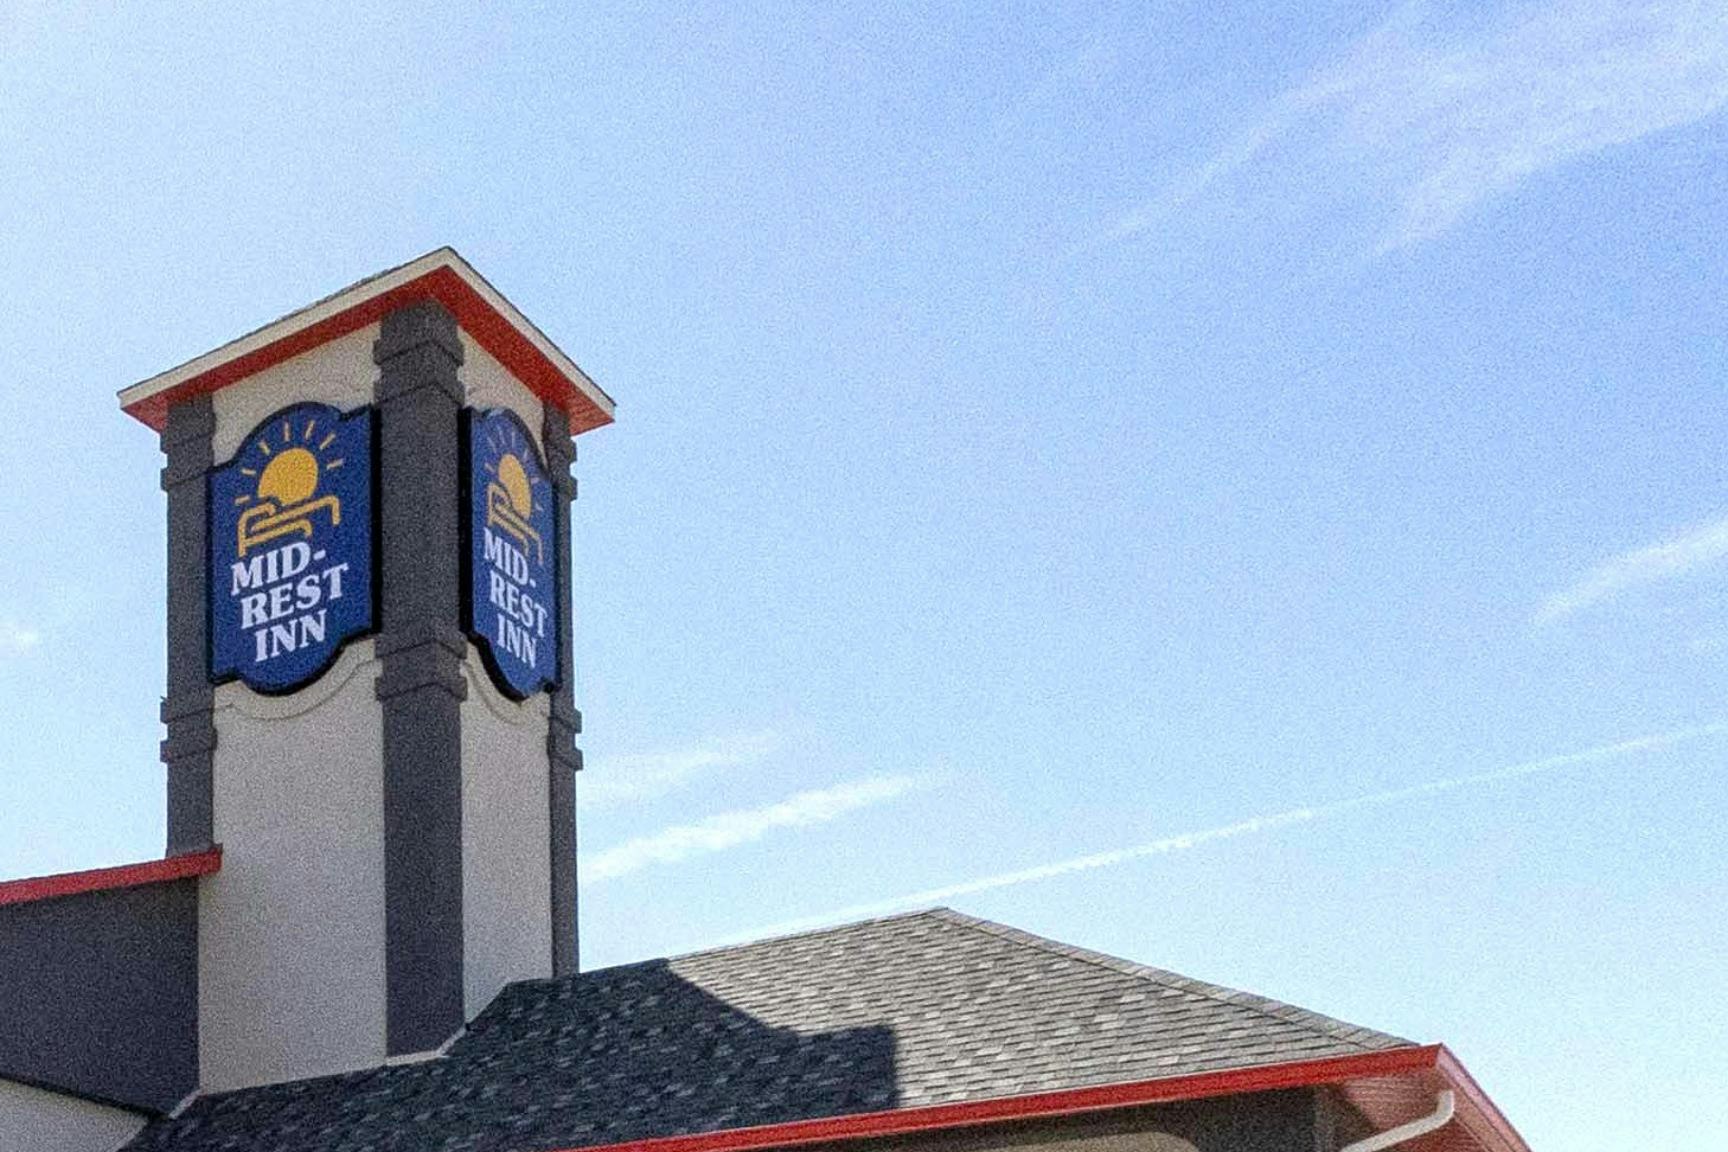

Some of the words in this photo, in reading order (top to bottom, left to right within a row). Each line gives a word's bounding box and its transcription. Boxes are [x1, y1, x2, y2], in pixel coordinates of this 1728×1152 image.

[230, 541, 327, 597] MID-
[240, 563, 348, 629] REST
[489, 571, 548, 639] REST
[254, 609, 327, 662] INN
[496, 614, 537, 668] INN
